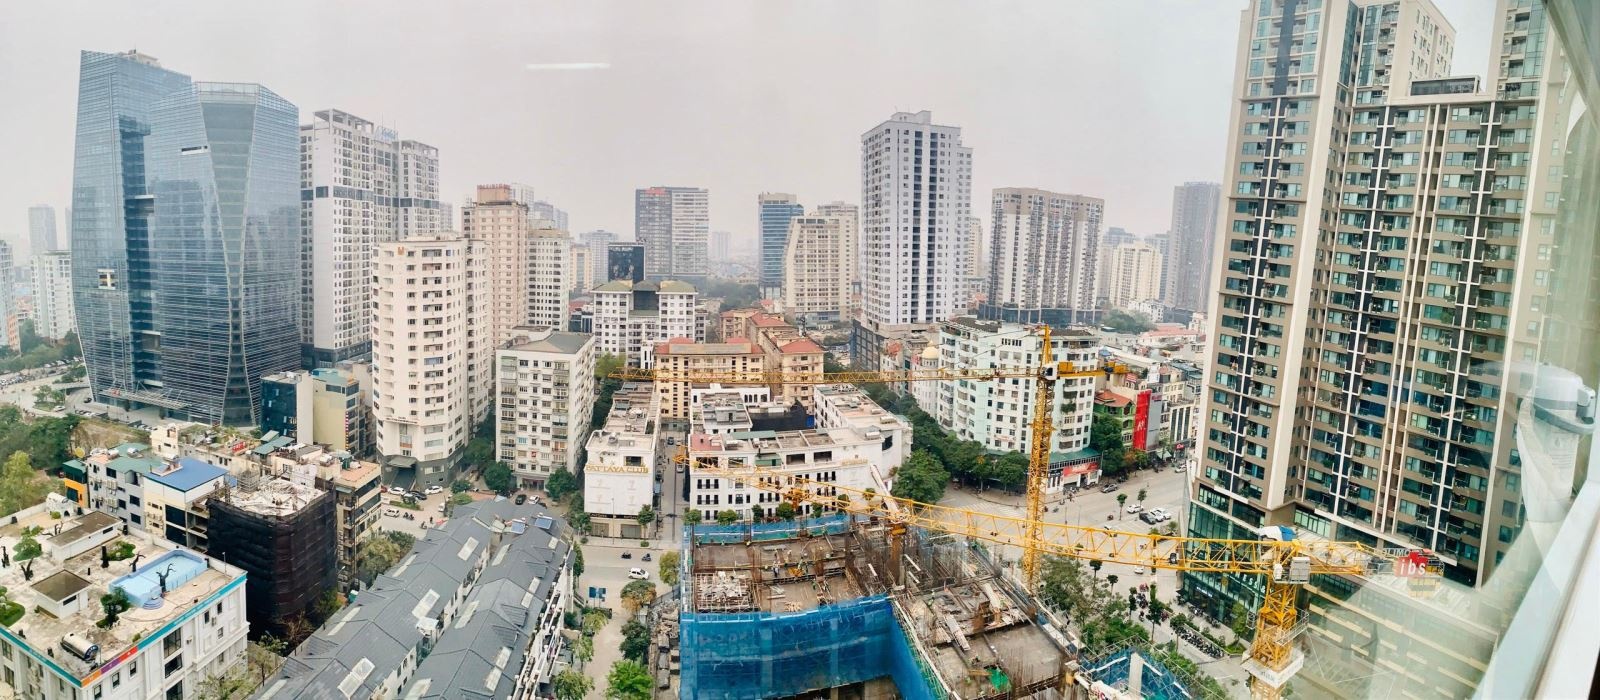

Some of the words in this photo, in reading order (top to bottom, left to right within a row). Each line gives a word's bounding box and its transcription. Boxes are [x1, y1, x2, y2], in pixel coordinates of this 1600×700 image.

[586, 464, 624, 473] PATTAYA
[627, 466, 649, 474] CLUB
[1400, 558, 1426, 576] ibs
